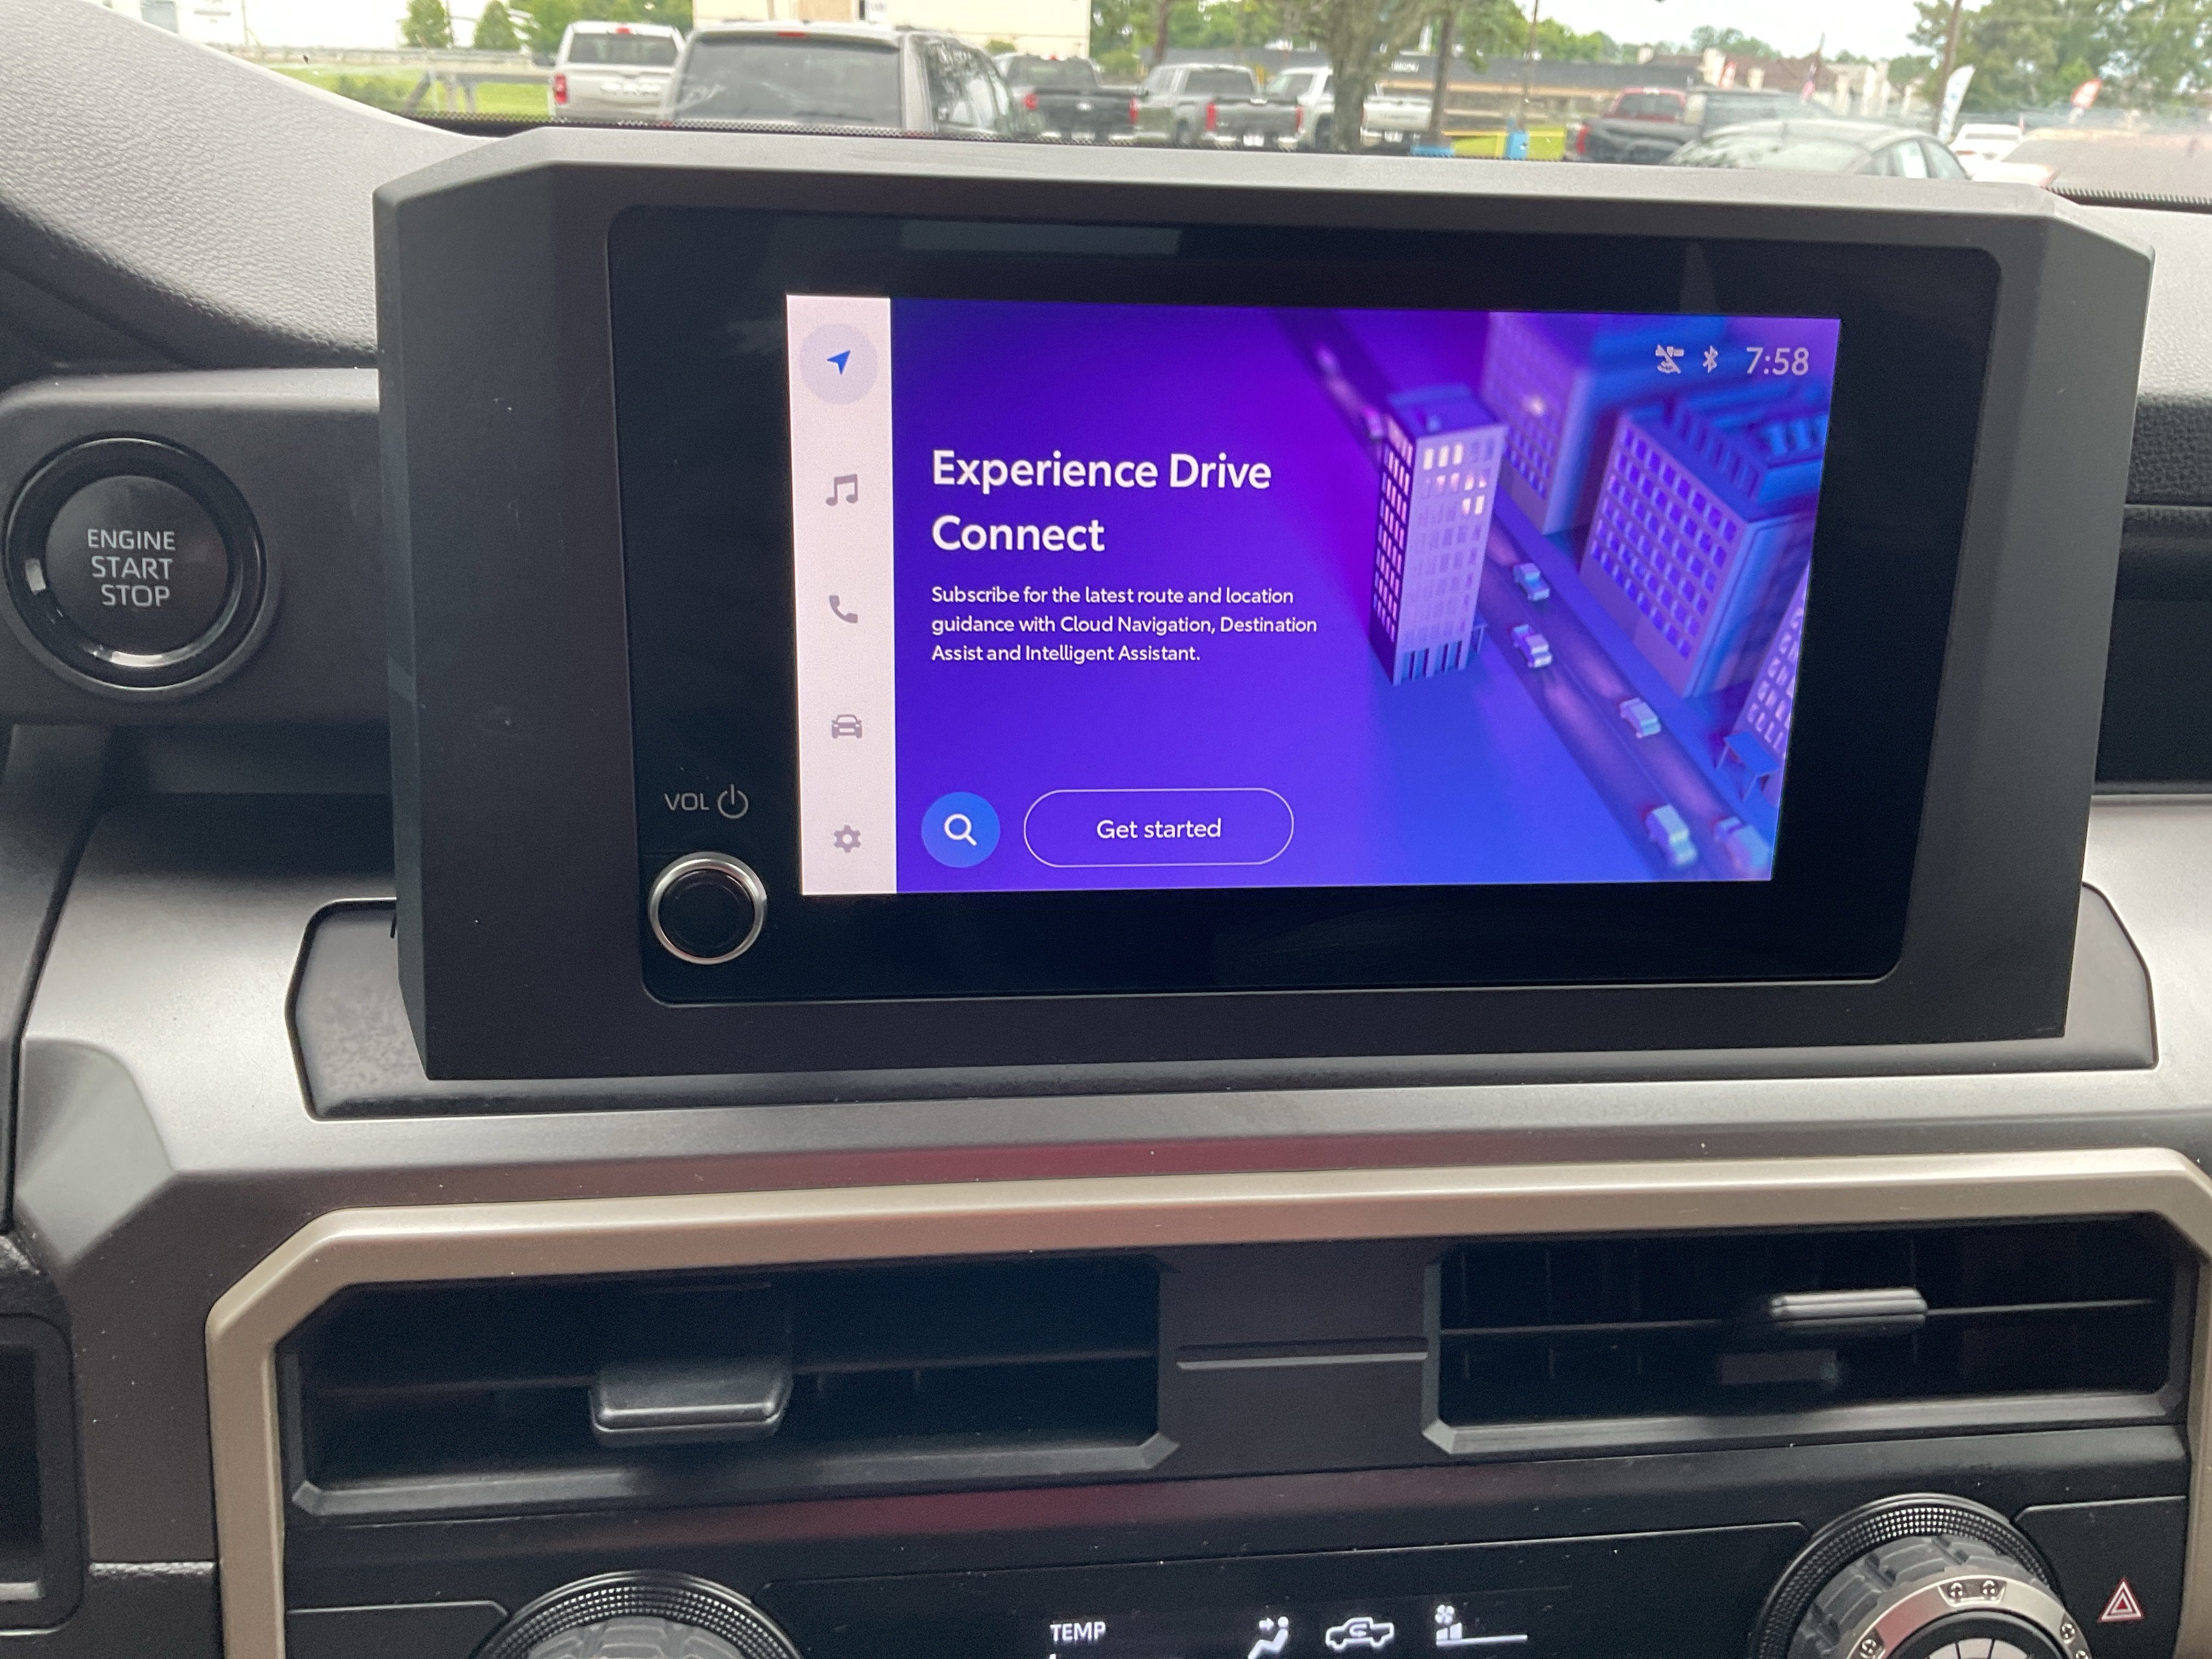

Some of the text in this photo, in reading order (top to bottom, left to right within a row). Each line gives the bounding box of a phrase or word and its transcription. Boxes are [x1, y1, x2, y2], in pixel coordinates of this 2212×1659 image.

[1746, 347, 1809, 375] 7:58
[933, 449, 1272, 495] Experience Drive
[87, 528, 176, 551] ENGINE
[932, 515, 1105, 552] Connect
[91, 555, 173, 580] START
[100, 584, 170, 607] STOP
[932, 585, 1294, 604] Subscribe for the latest route and location
[932, 615, 1317, 636] guidance with Cloud Navigation, Destination
[932, 644, 1200, 665] Assist and Intelligent Assistant.
[664, 793, 709, 811] VOL
[1097, 817, 1222, 839] Get started
[1050, 1621, 1106, 1643] TEMP
